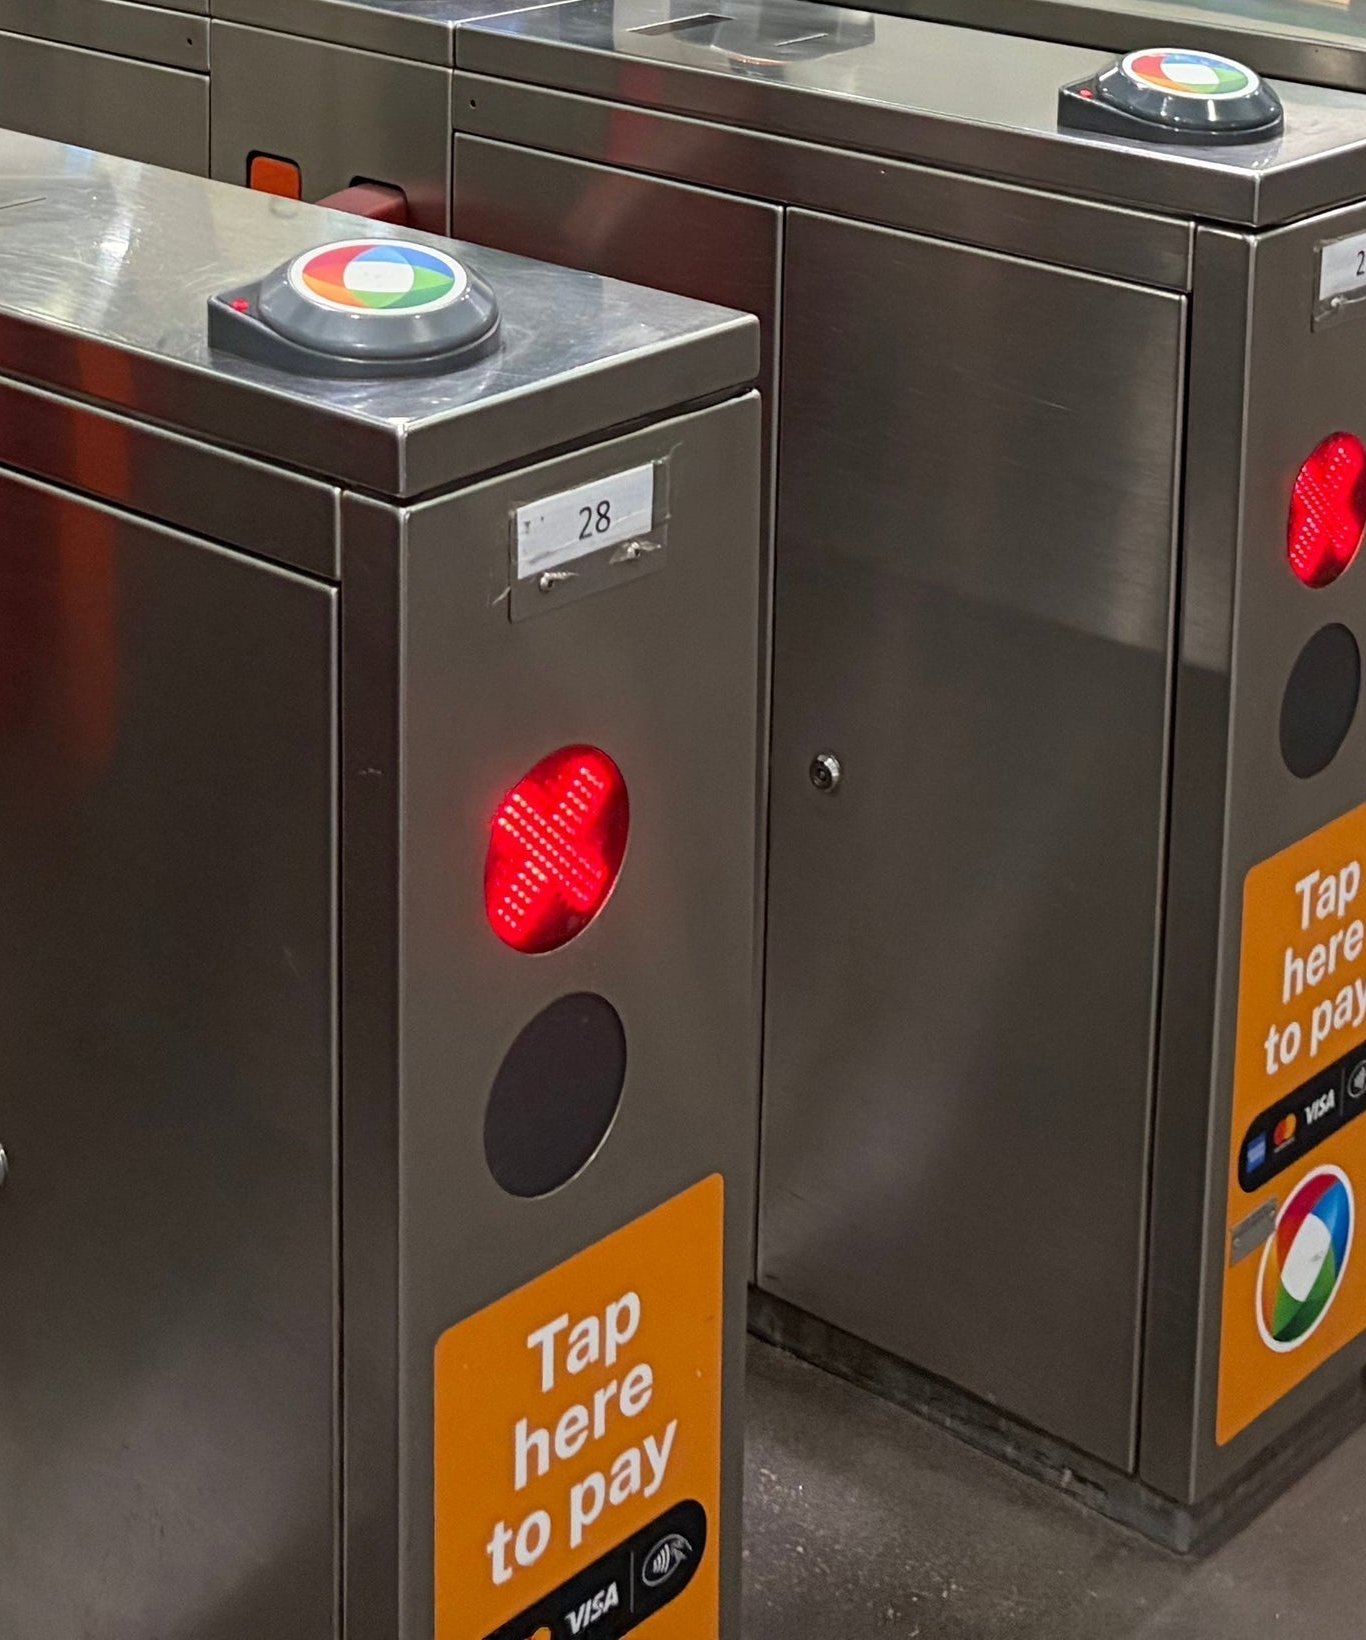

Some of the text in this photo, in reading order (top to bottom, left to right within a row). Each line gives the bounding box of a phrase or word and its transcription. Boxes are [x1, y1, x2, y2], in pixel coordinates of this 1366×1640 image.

[579, 500, 611, 540] 28
[1295, 859, 1361, 931] Tap
[1282, 918, 1364, 1004] here
[1264, 1020, 1300, 1076] to
[1304, 1088, 1335, 1125] VISA
[527, 1291, 641, 1393] Tap
[514, 1362, 653, 1492] here
[487, 1419, 678, 1586] to pay
[565, 1581, 619, 1636] VISA
